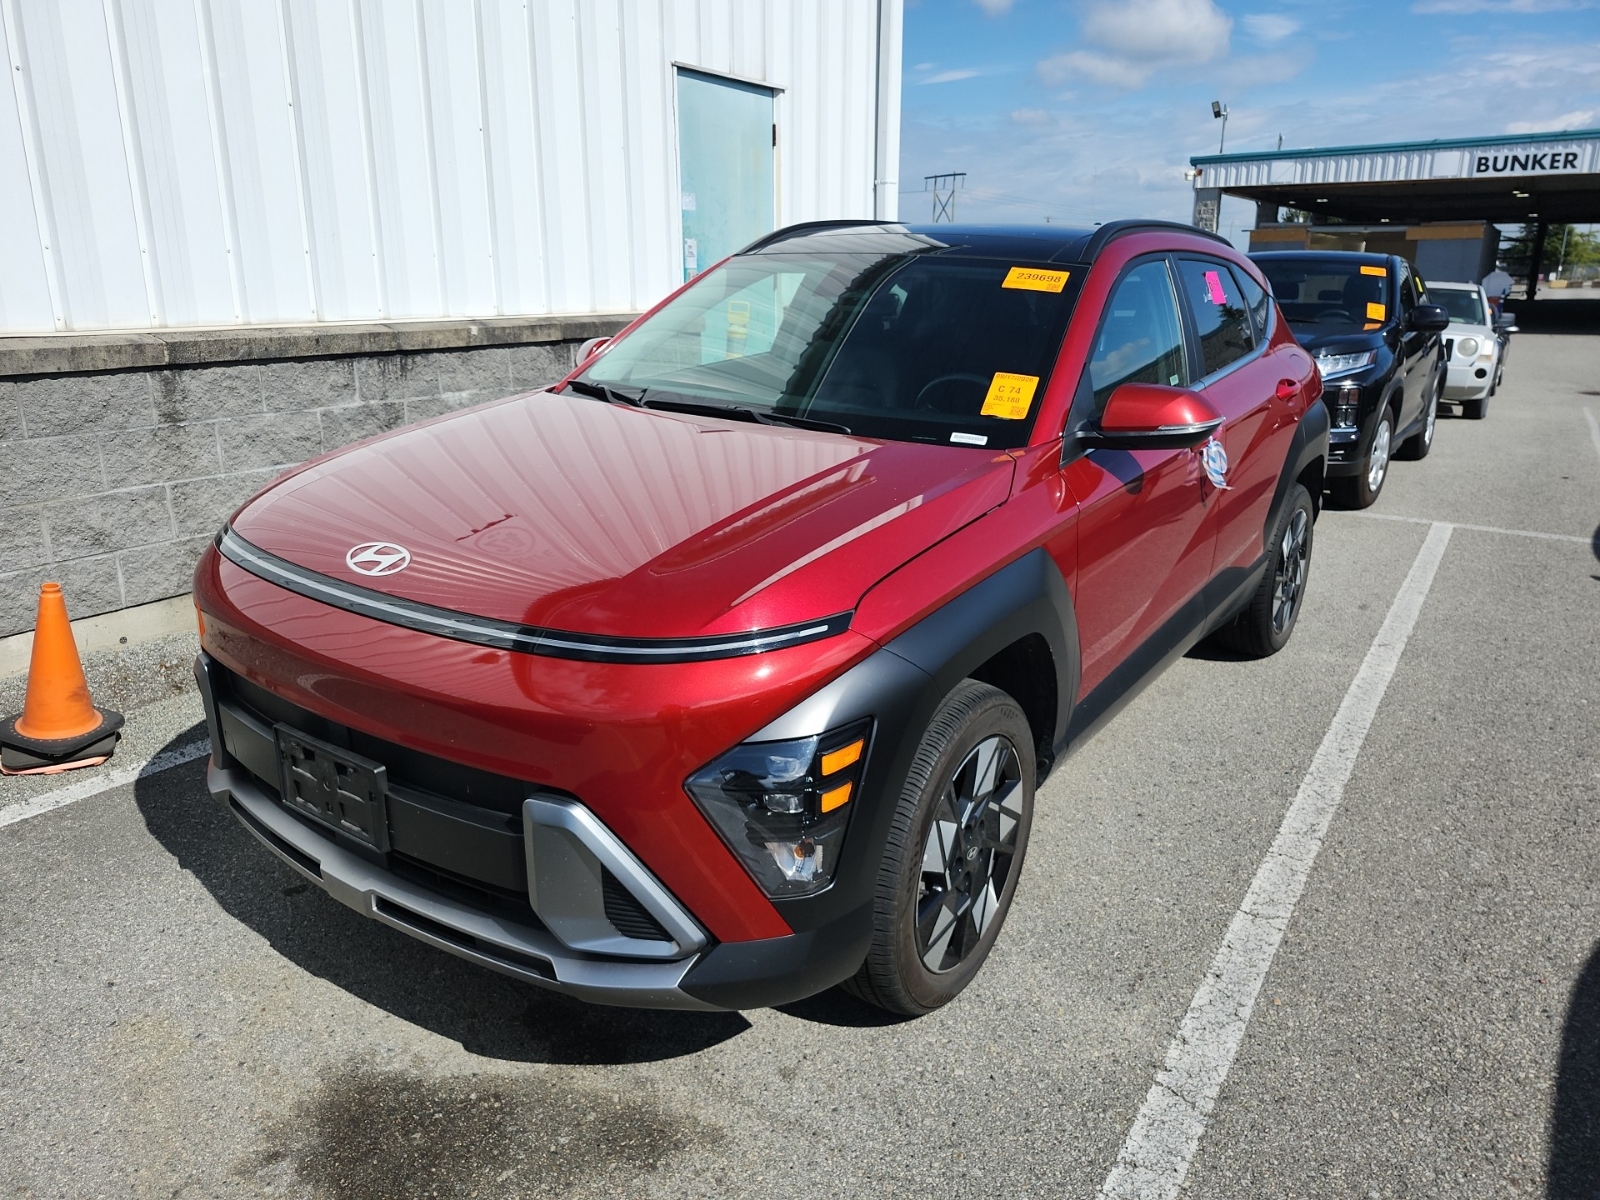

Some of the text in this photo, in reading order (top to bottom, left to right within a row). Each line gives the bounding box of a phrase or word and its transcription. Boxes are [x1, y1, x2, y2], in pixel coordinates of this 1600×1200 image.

[1476, 152, 1578, 173] BUNKER
[1016, 272, 1062, 283] 239698
[998, 385, 1021, 394] C 74
